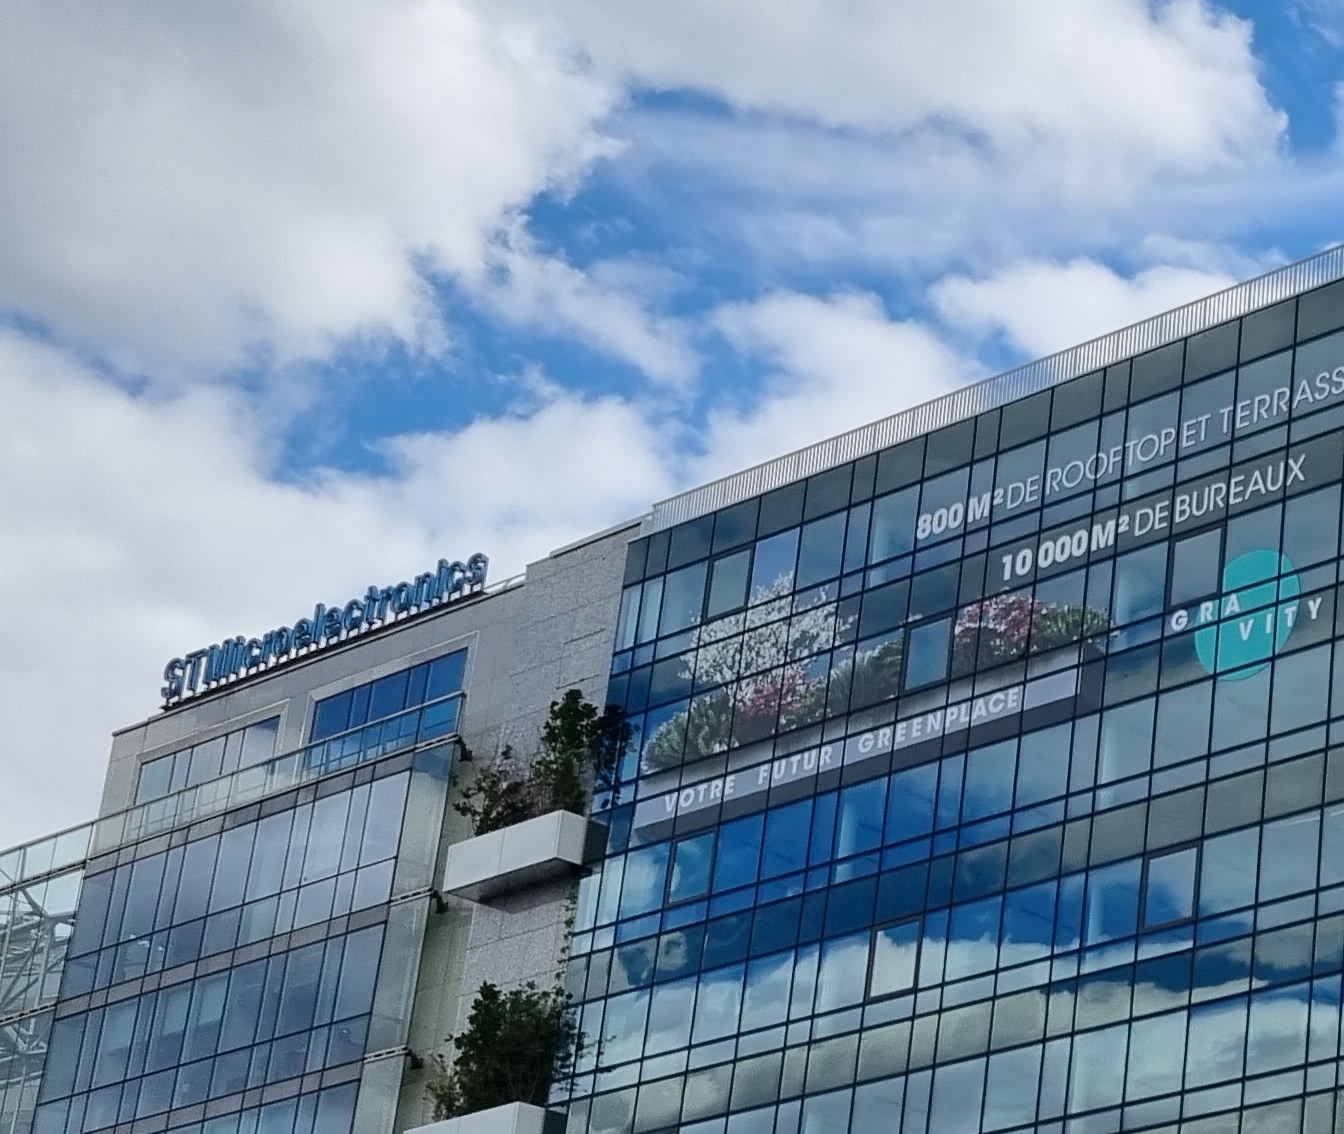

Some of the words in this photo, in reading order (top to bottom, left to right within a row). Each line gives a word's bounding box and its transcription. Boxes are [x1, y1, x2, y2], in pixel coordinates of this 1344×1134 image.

[1006, 474, 1041, 510] DE
[1045, 428, 1176, 496] ROOFTOP
[1181, 414, 1212, 449] ET
[1133, 501, 1170, 537] DE
[1175, 453, 1306, 524] BUREAUX
[664, 774, 736, 814] VOTRE
[757, 745, 833, 786] FUTUR
[857, 686, 1020, 753] GREENPLACE
